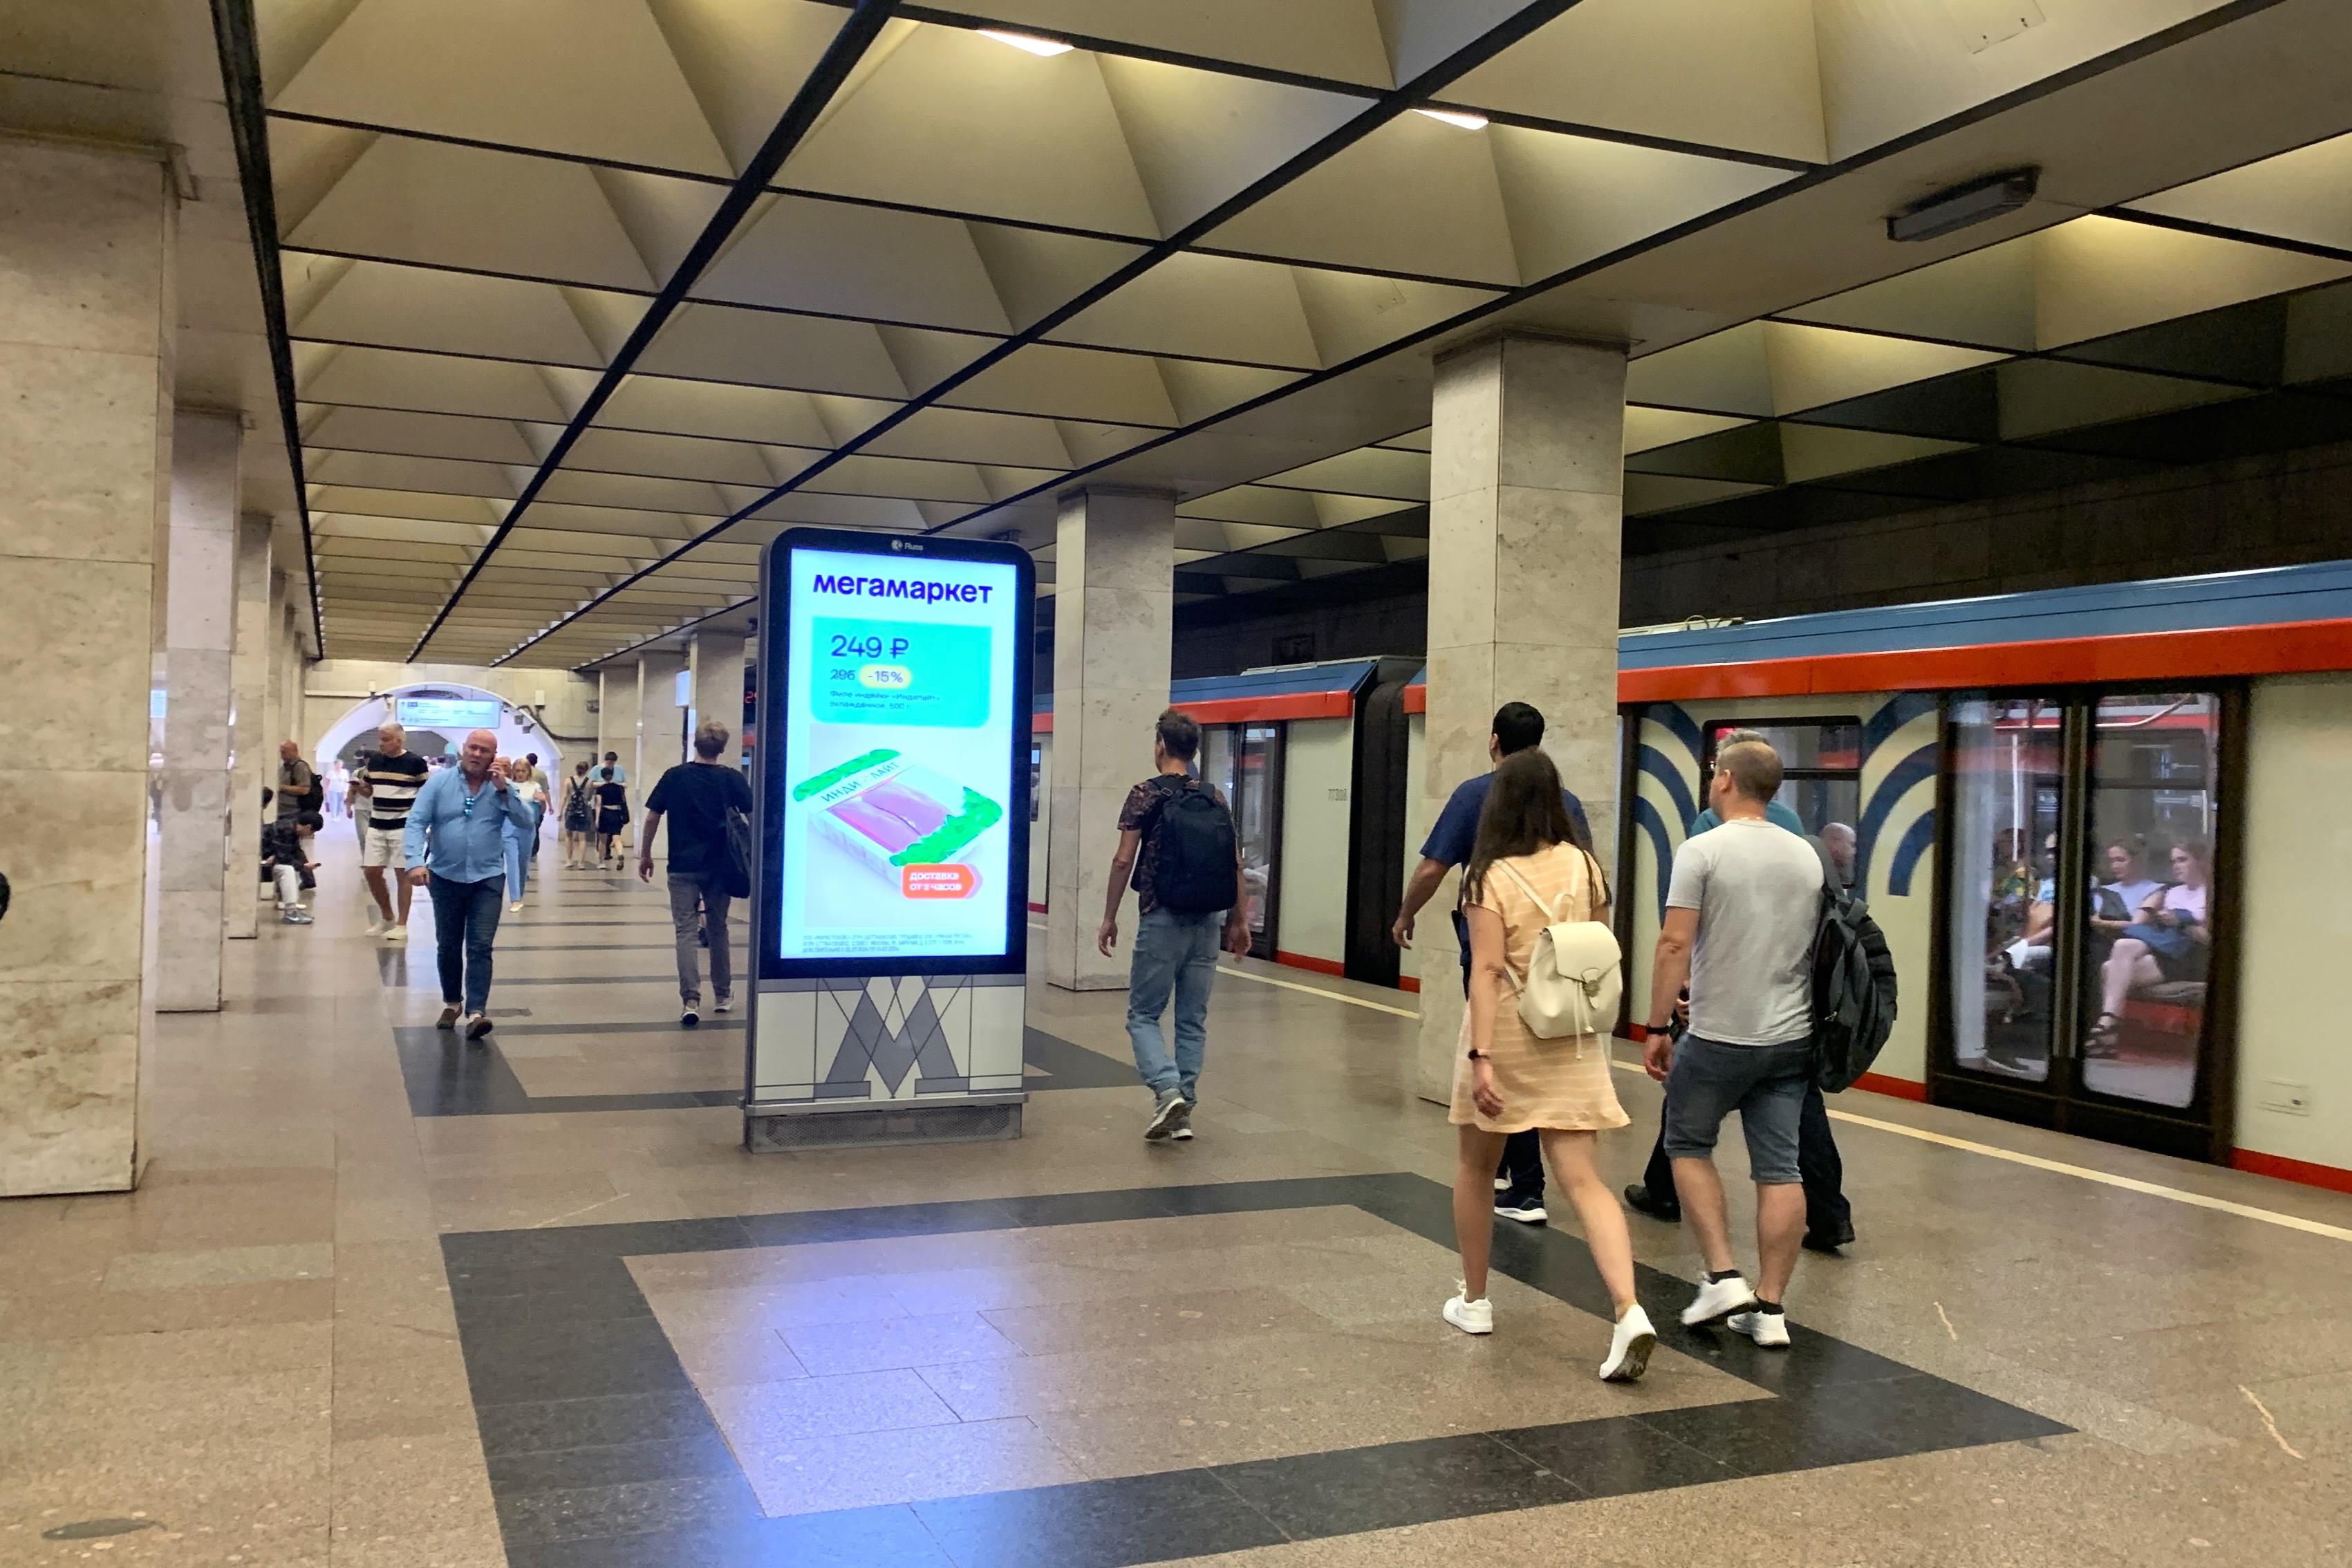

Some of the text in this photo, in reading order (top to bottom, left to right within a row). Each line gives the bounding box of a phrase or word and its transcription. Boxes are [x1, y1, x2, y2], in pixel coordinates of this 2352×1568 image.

[812, 574, 993, 605] мегамаркет
[830, 634, 883, 659] 249
[868, 670, 904, 683] -15%
